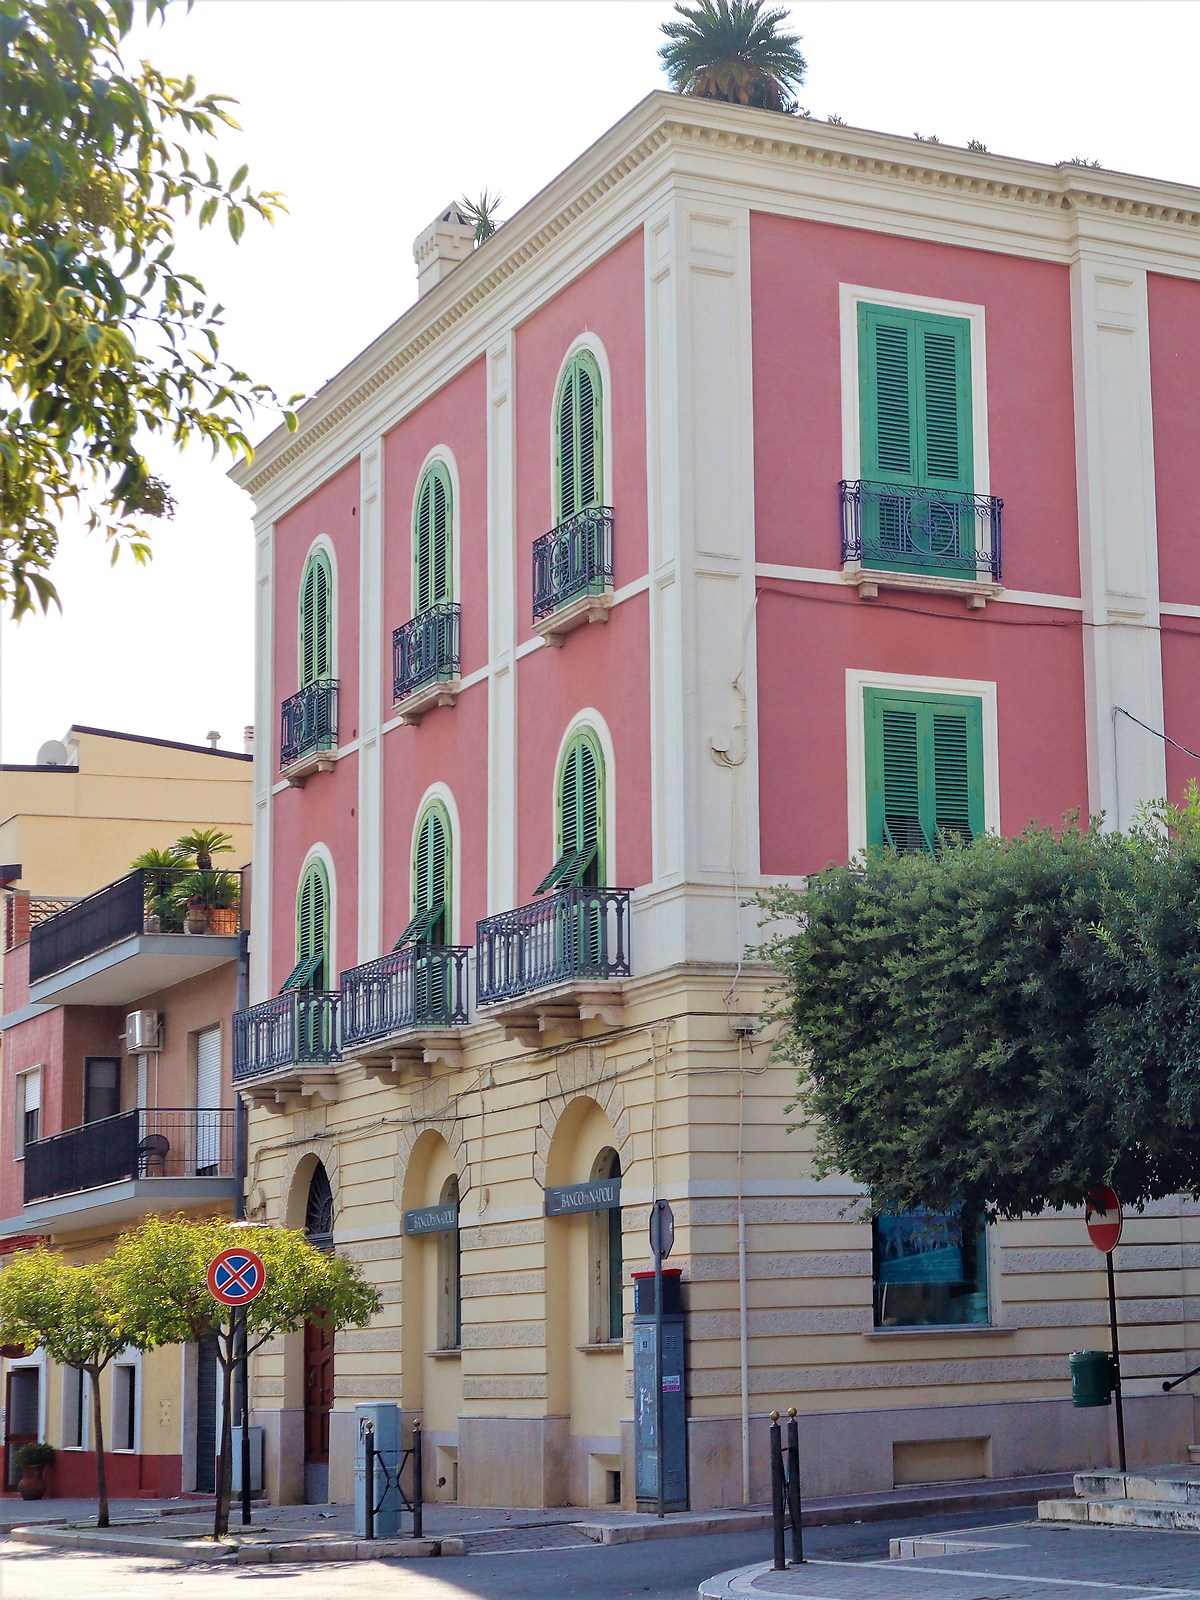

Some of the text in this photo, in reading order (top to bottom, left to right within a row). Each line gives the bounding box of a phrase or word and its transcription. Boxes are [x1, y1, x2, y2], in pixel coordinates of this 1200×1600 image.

[560, 1191, 584, 1208] BANCO
[589, 1186, 614, 1204] NAPOLI
[414, 1213, 432, 1228] BANCO
[436, 1210, 455, 1224] NAPOLI
